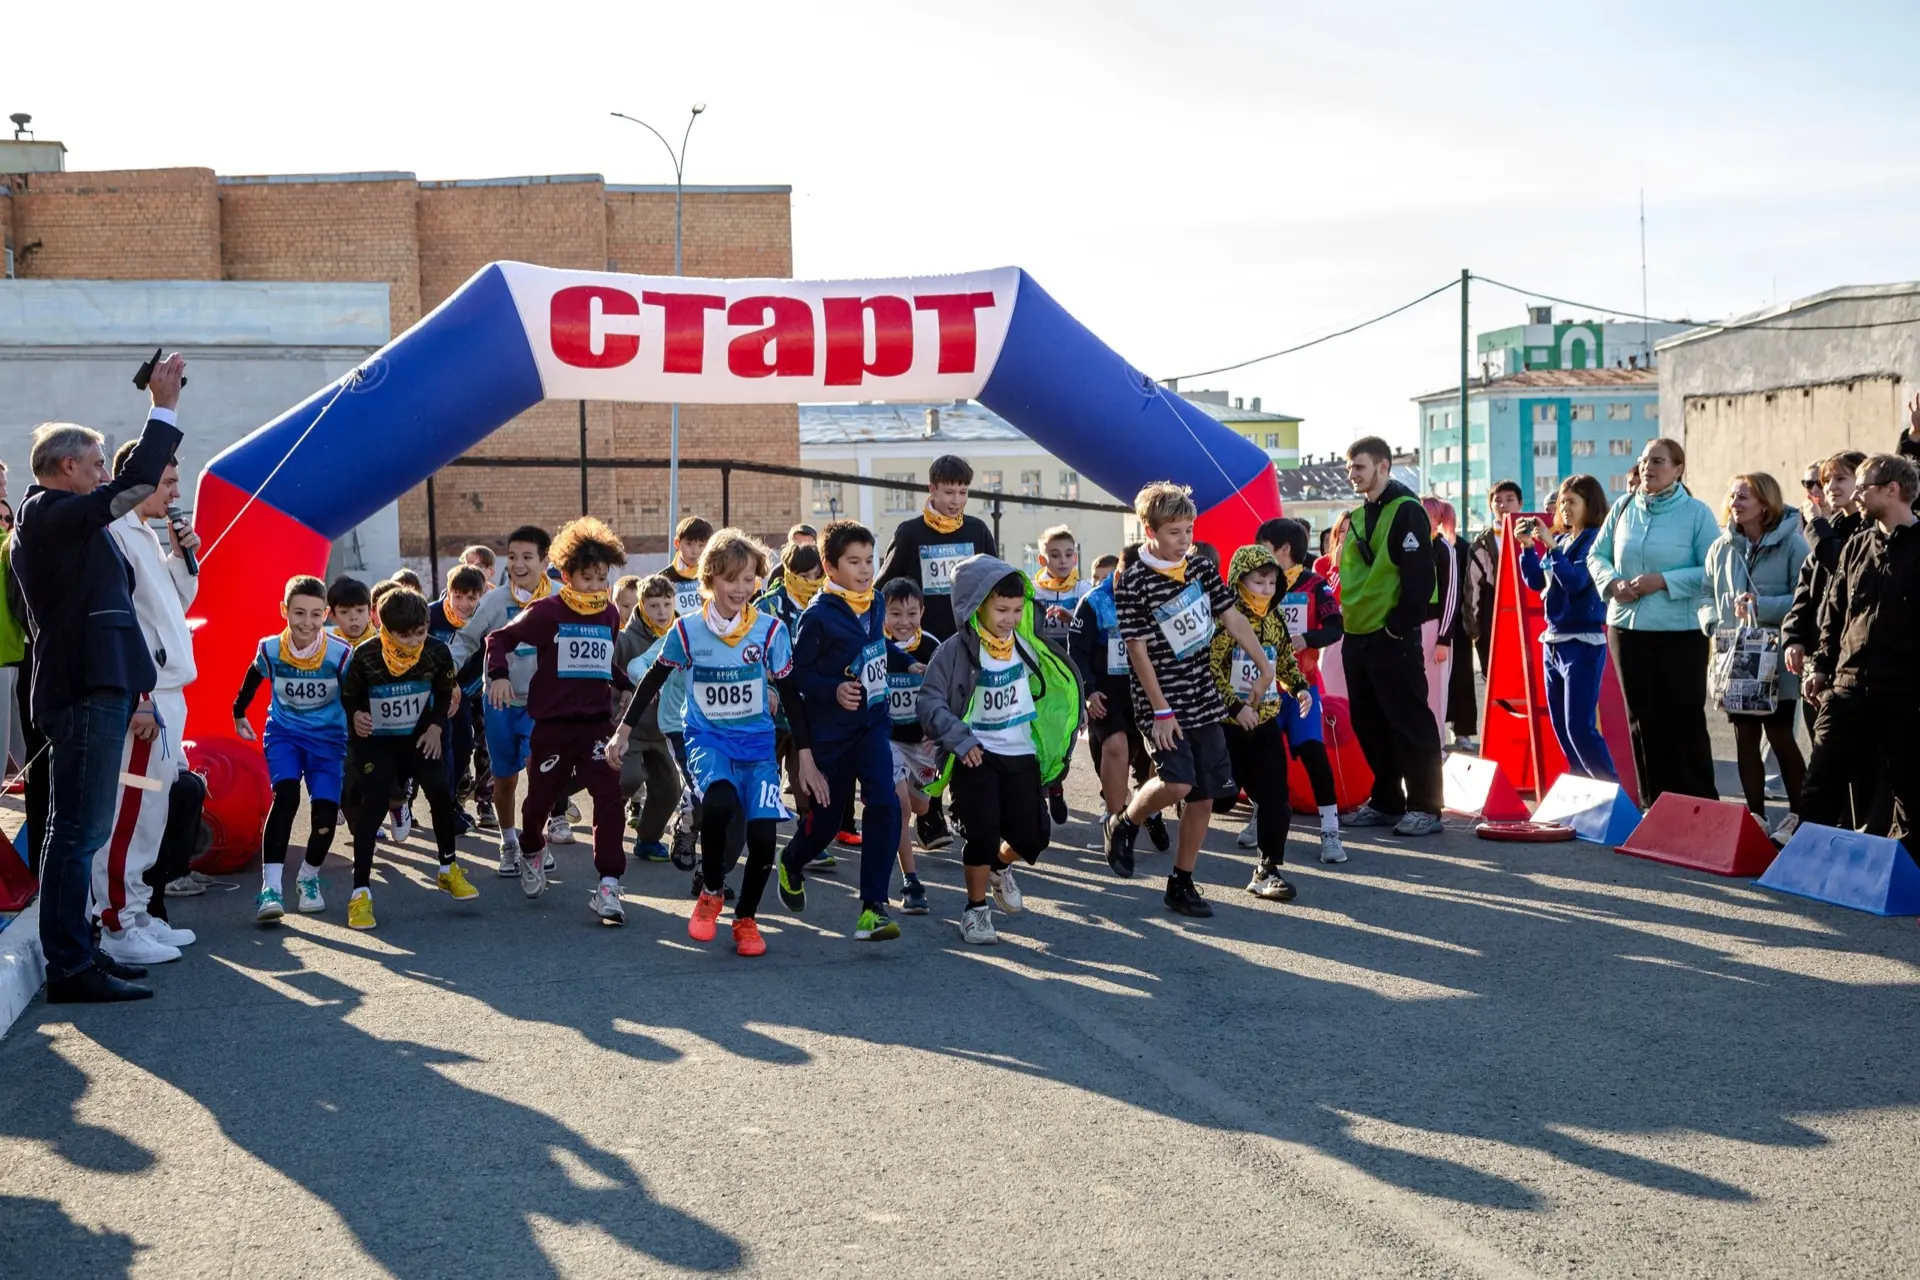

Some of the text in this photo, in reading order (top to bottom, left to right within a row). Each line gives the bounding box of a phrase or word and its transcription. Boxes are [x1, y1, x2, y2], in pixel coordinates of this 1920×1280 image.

[1173, 601, 1210, 636] 9514
[569, 641, 607, 660] 9286
[285, 682, 327, 699] 6483
[705, 684, 752, 705] 9085
[887, 691, 920, 708] 037
[983, 685, 1018, 710] 9052
[381, 698, 420, 718] 9511
